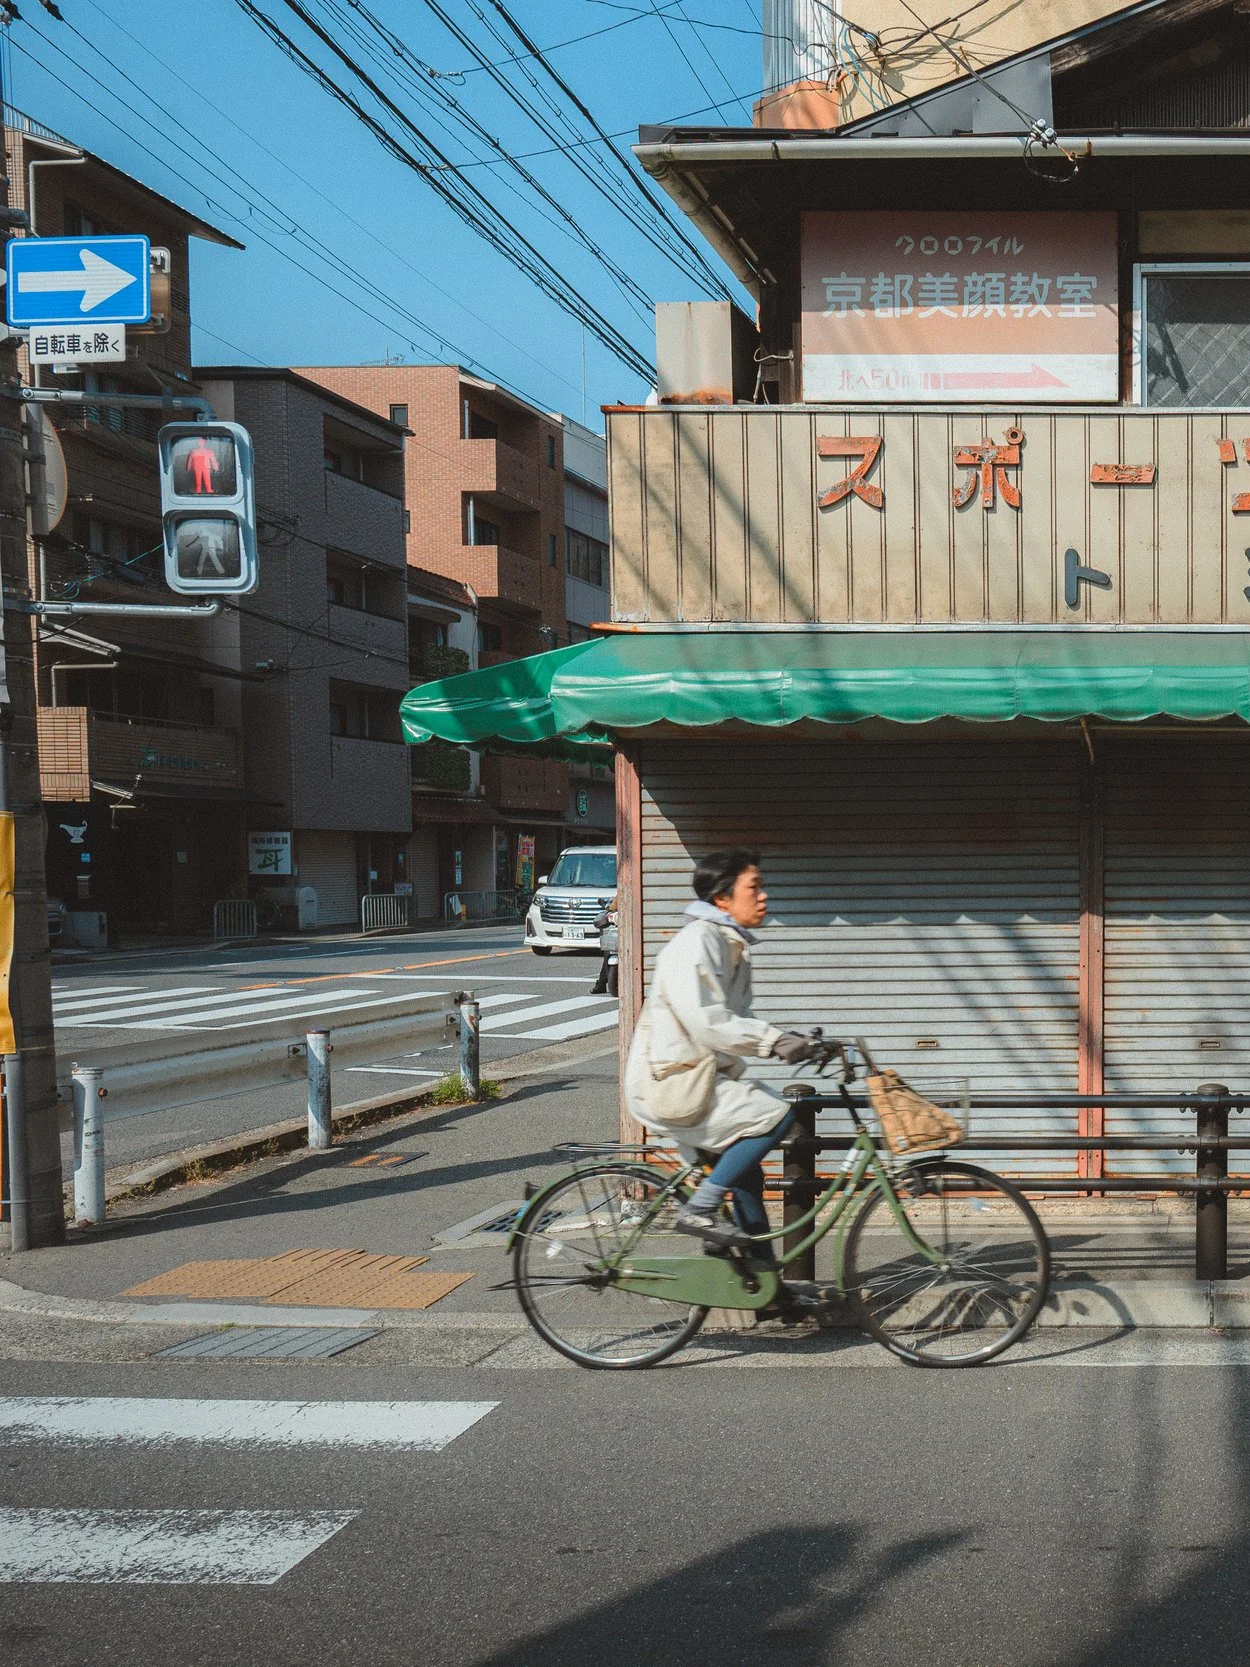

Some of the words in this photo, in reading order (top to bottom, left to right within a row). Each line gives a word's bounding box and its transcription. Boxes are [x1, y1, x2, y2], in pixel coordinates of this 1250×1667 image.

[821, 272, 1098, 319] 京都美顔教室
[35, 333, 120, 355] 自転車を除く
